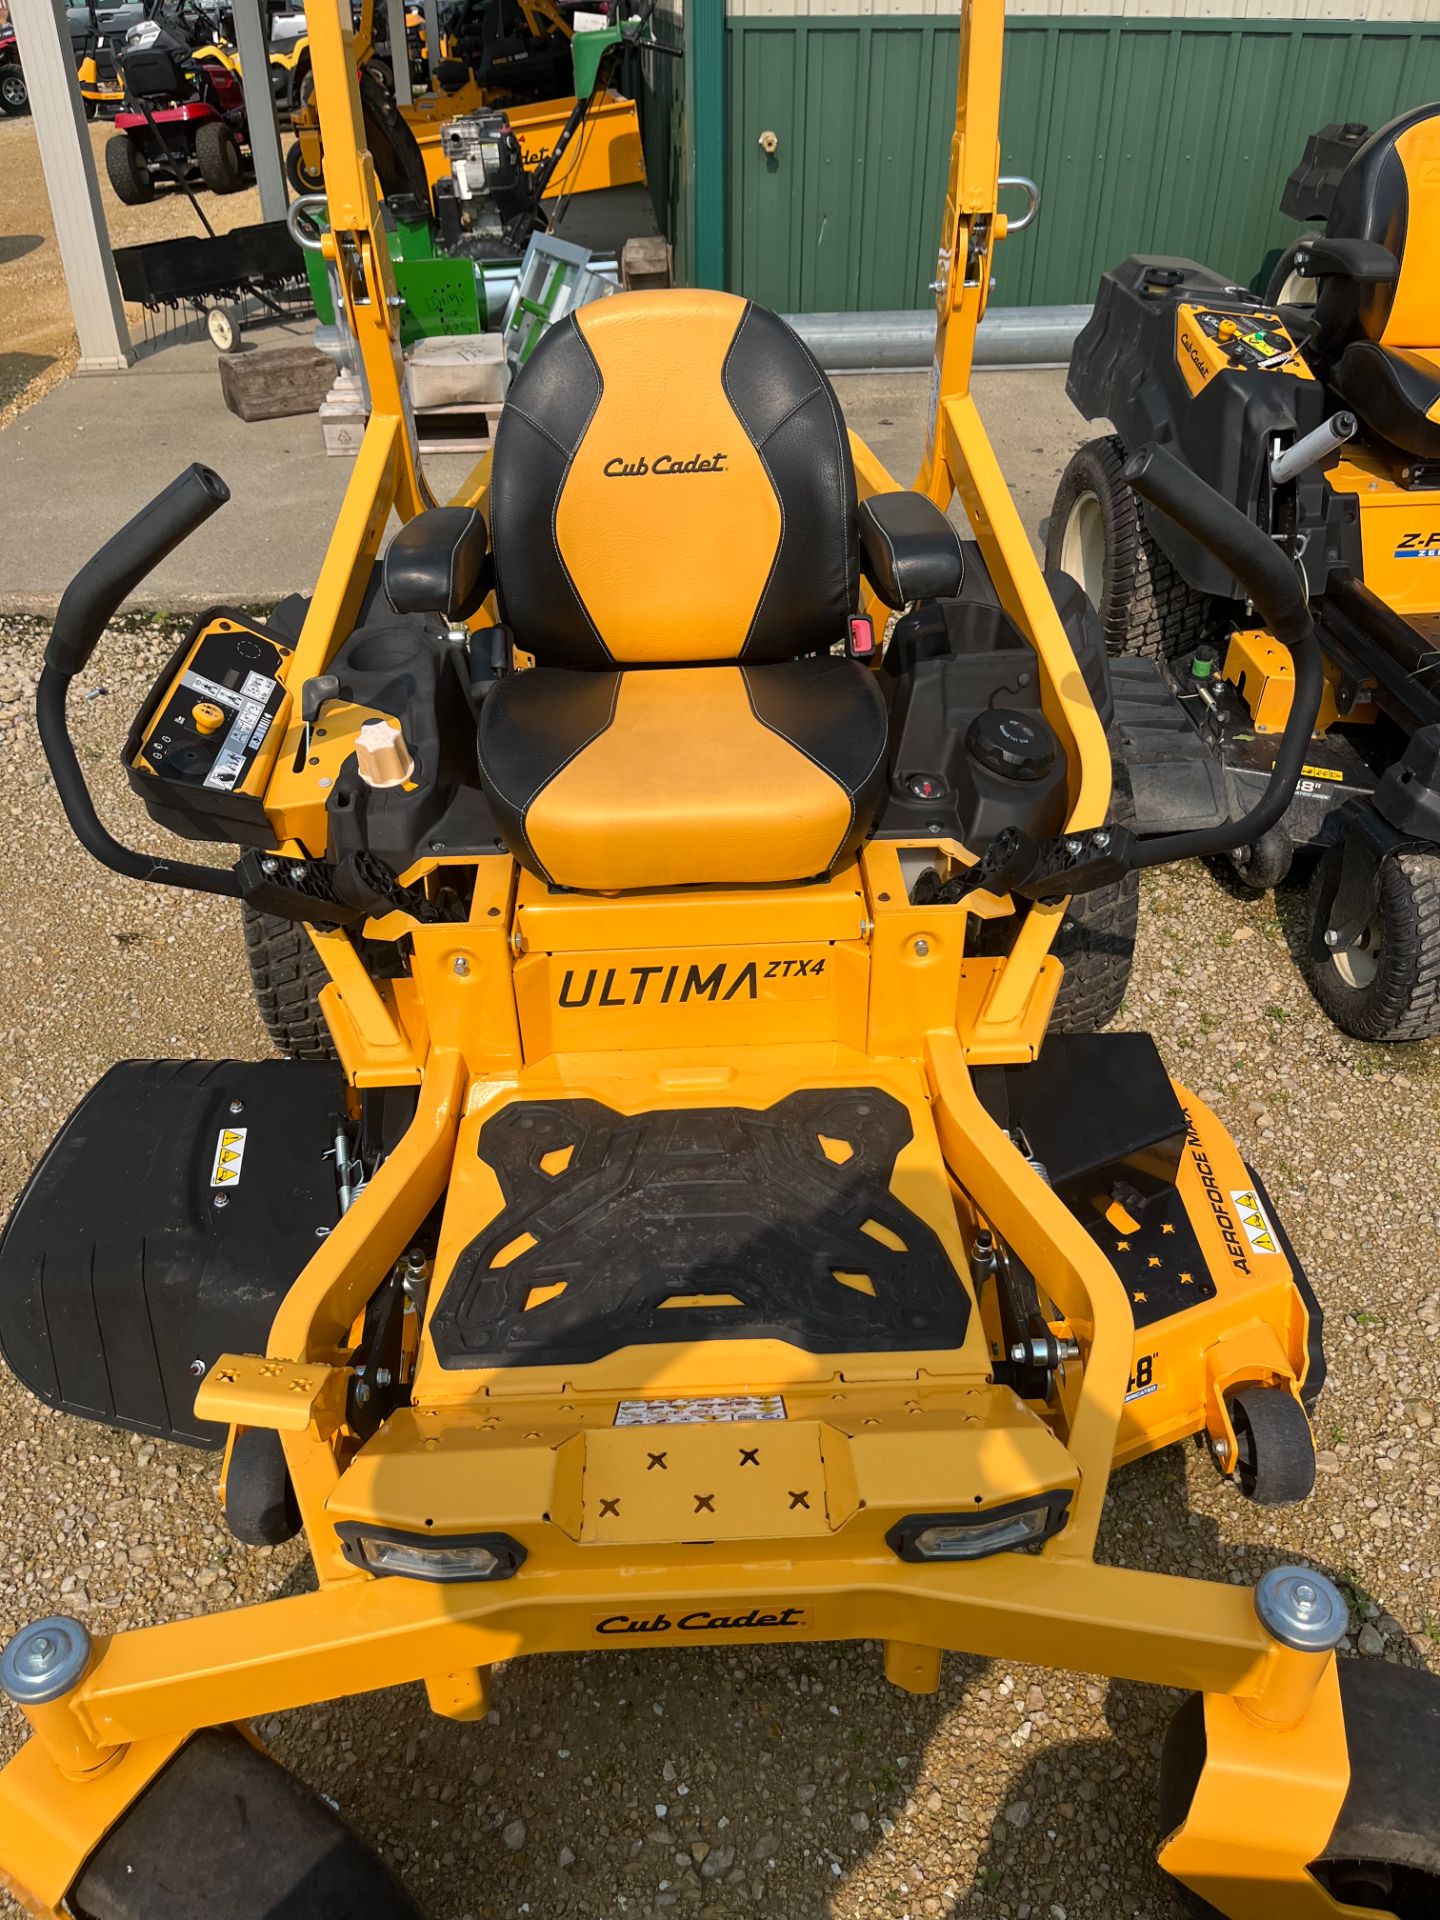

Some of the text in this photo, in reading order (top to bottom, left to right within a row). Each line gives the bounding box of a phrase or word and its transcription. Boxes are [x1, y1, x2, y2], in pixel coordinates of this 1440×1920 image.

[521, 147, 549, 165] det
[1180, 333, 1210, 380] Cub Cadet
[603, 452, 728, 477] Cub Cadet
[558, 958, 826, 1009] ULTIMA ZTX4
[1191, 1151, 1252, 1276] AEROFORCE
[595, 1607, 805, 1634] Cub Cadet
